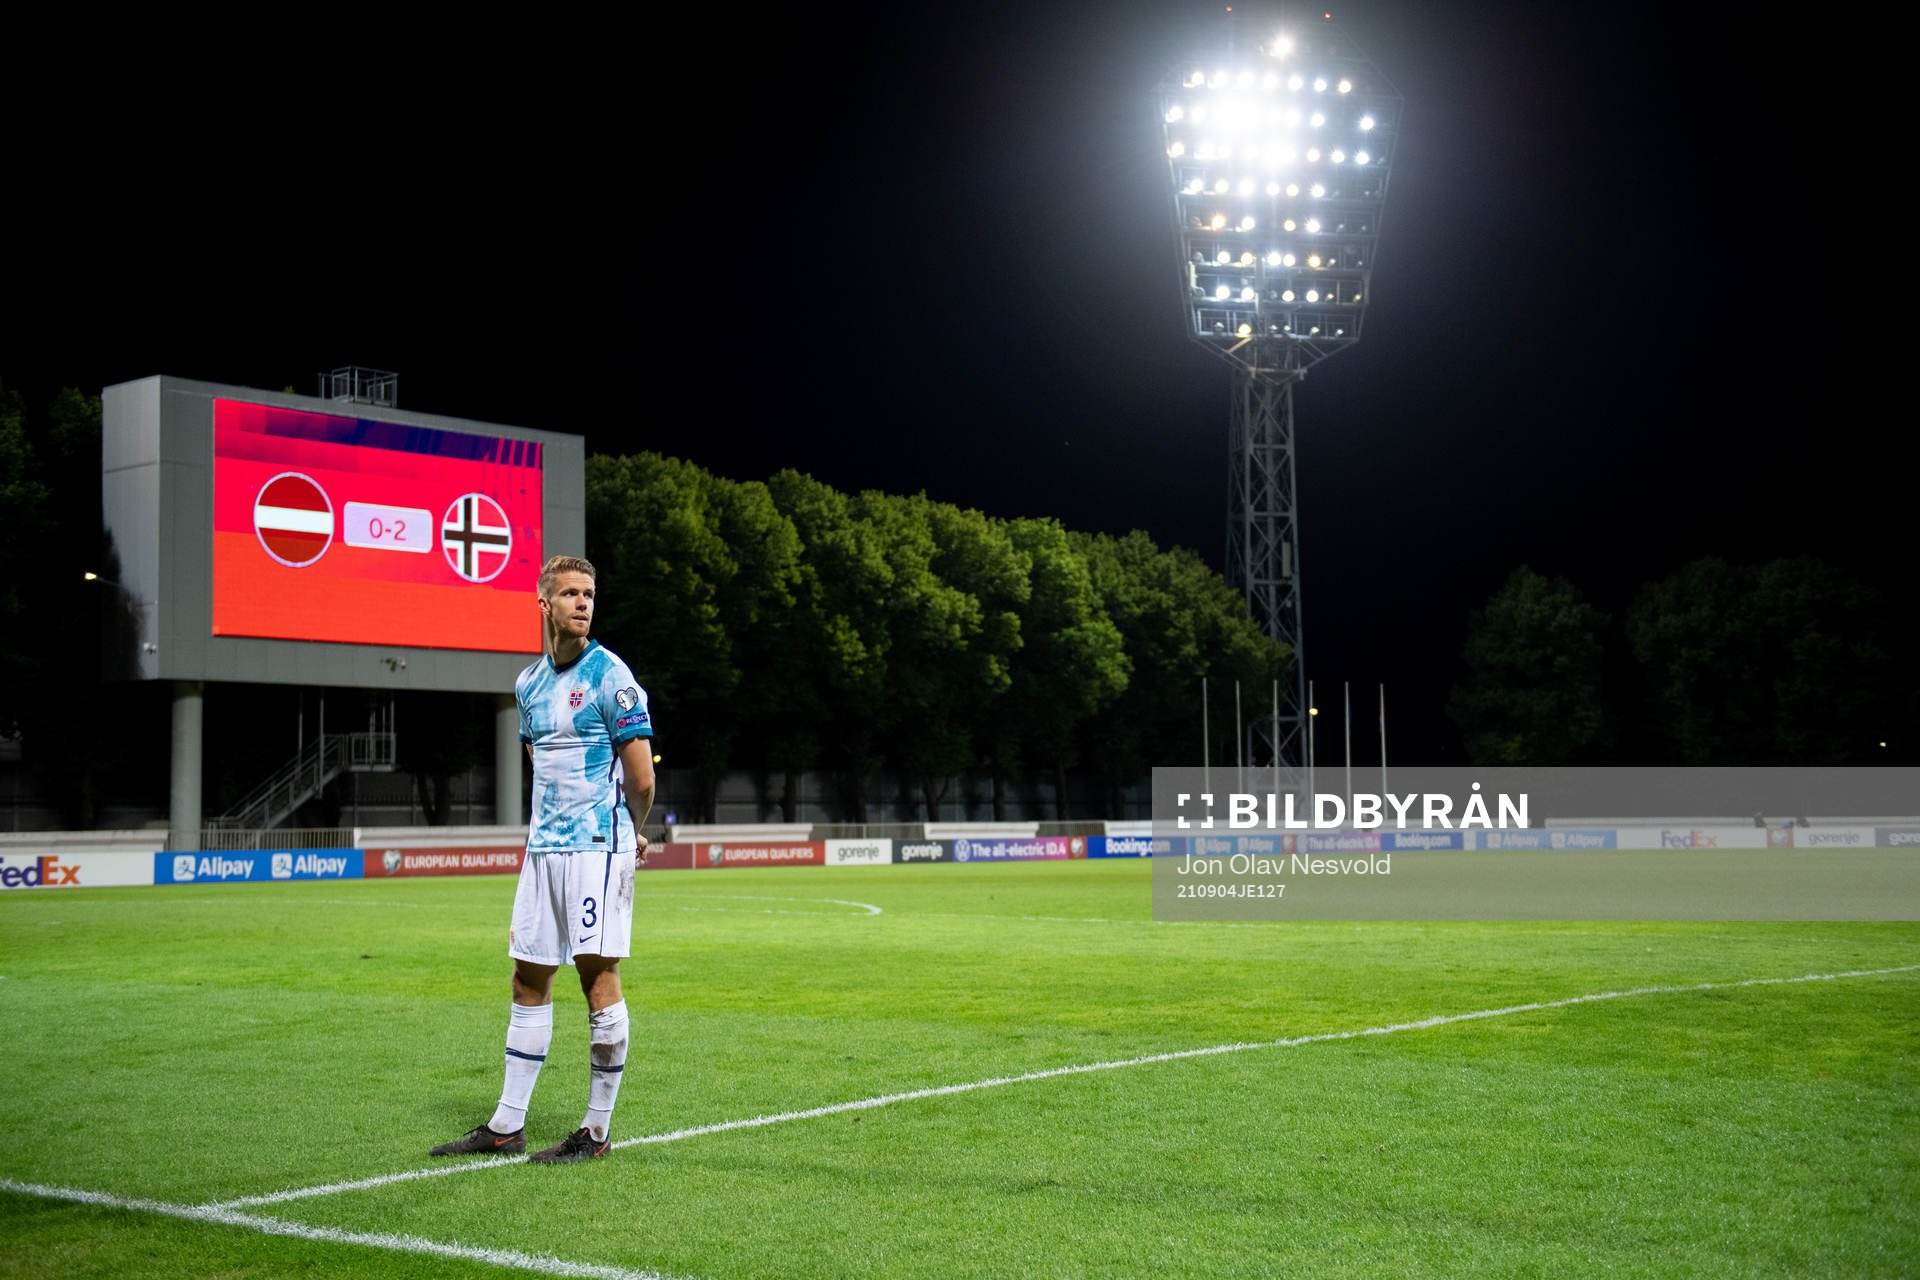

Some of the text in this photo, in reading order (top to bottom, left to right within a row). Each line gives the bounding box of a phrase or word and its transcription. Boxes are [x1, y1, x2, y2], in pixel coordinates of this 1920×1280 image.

[368, 518, 406, 541] 0-2
[1395, 833, 1450, 849] Booking.com
[1503, 833, 1540, 848] Alipay
[1568, 833, 1605, 848] Alipay
[1661, 830, 1718, 848] FedEx
[1808, 830, 1860, 846] gorenje
[725, 847, 814, 860] EUROPEAN QUALIFIERS
[837, 843, 880, 861] gorenje
[902, 842, 943, 861] gorenje
[972, 842, 1067, 857] The all-electric ID.4
[1106, 839, 1171, 855] Booking.com
[198, 857, 254, 879] Alipay
[295, 854, 347, 878] Alipay
[404, 853, 519, 869] EUROPEAN QUALIFIERS
[0, 856, 81, 888] edEx
[582, 897, 597, 928] 3
